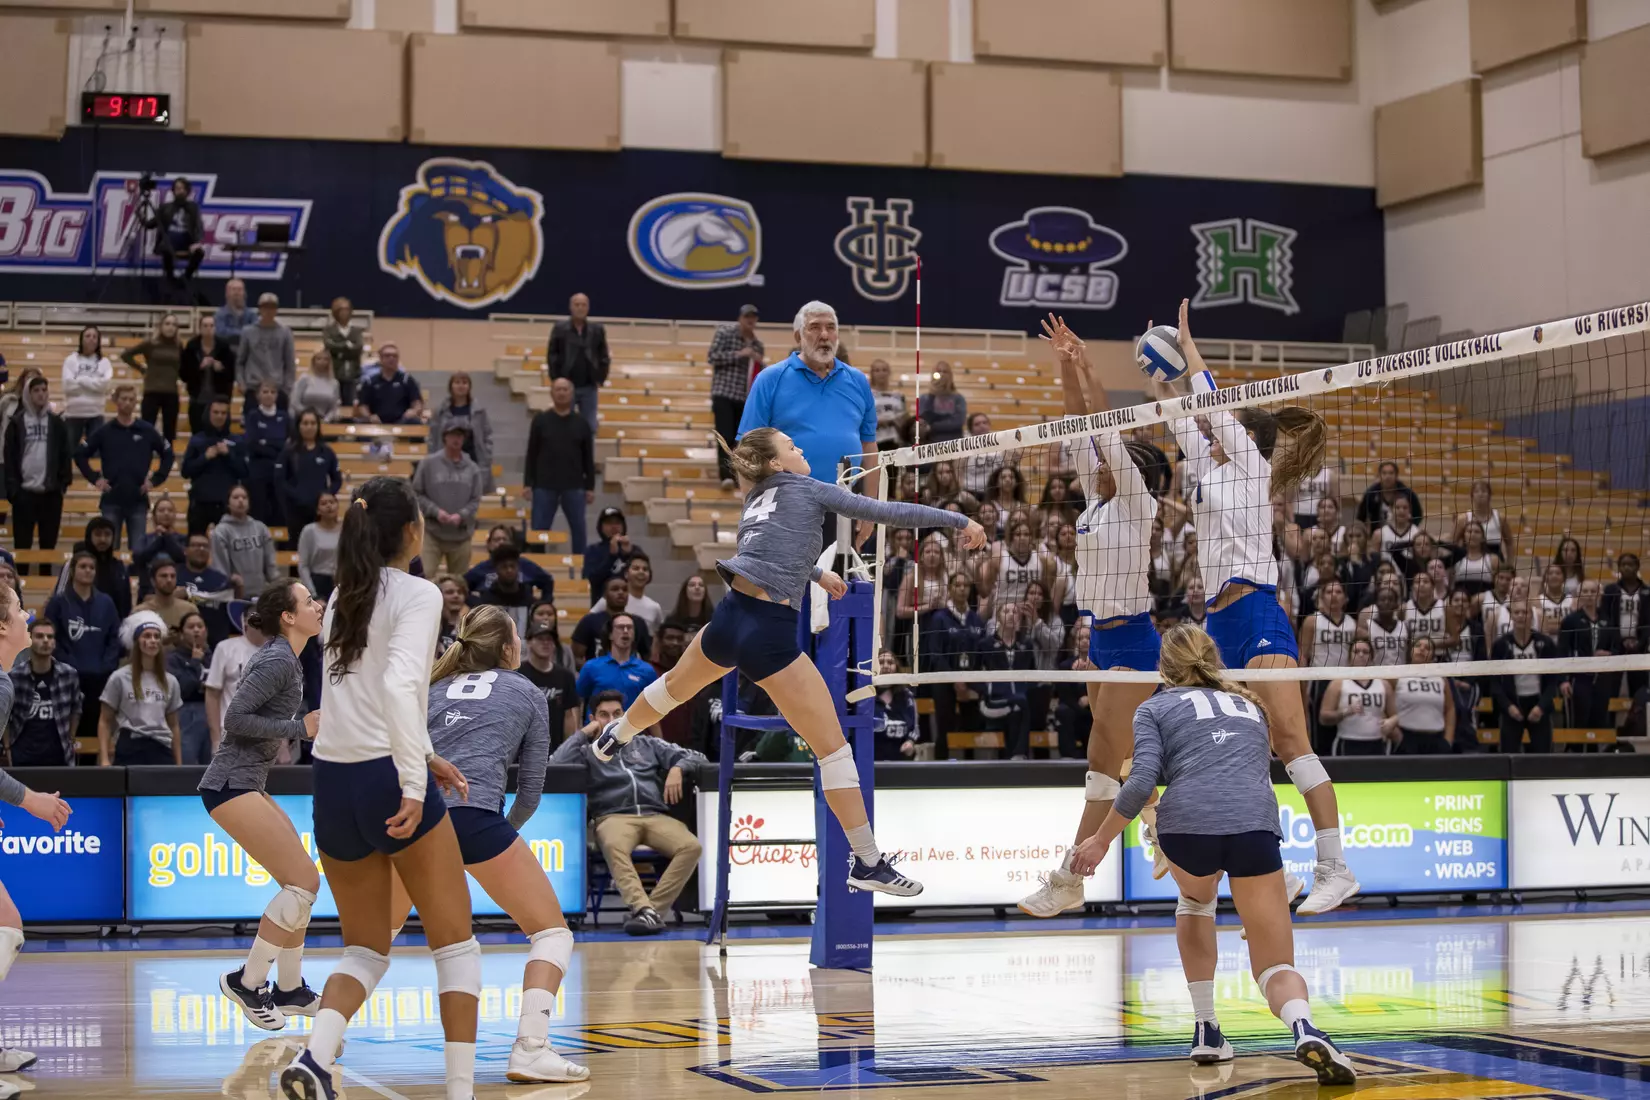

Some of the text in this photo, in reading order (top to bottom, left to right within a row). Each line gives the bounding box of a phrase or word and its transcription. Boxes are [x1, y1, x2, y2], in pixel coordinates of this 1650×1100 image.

[109, 96, 157, 117] 9:17
[1005, 271, 1115, 304] UCSB
[1574, 317, 1592, 336] UC
[1357, 334, 1503, 378] UC RIVERSIDE VOLLEYBALL
[1181, 375, 1300, 411] UC RIVERSIDE VOLLEYBALL
[1037, 407, 1136, 439] UC RIVERSIDE VOLLEYBALL
[927, 441, 959, 458] RIVERSIDE
[960, 433, 1000, 452] VOLLEYBALL
[743, 487, 779, 521] 4
[233, 535, 264, 552] CBU
[1005, 569, 1039, 584] CBU
[1408, 618, 1441, 633] CBU
[1321, 629, 1353, 643] CBU
[1374, 635, 1407, 650] CBU
[446, 670, 498, 699] 8
[1408, 680, 1442, 693] CBU
[1348, 693, 1384, 708] CBU
[1435, 795, 1484, 811] PRINT
[1435, 818, 1483, 833] SIGNS
[927, 847, 959, 861] Ave.
[965, 847, 975, 860] &
[981, 845, 1050, 861] Riverside
[1435, 841, 1473, 856] WEB
[1435, 862, 1496, 879] WRAPS
